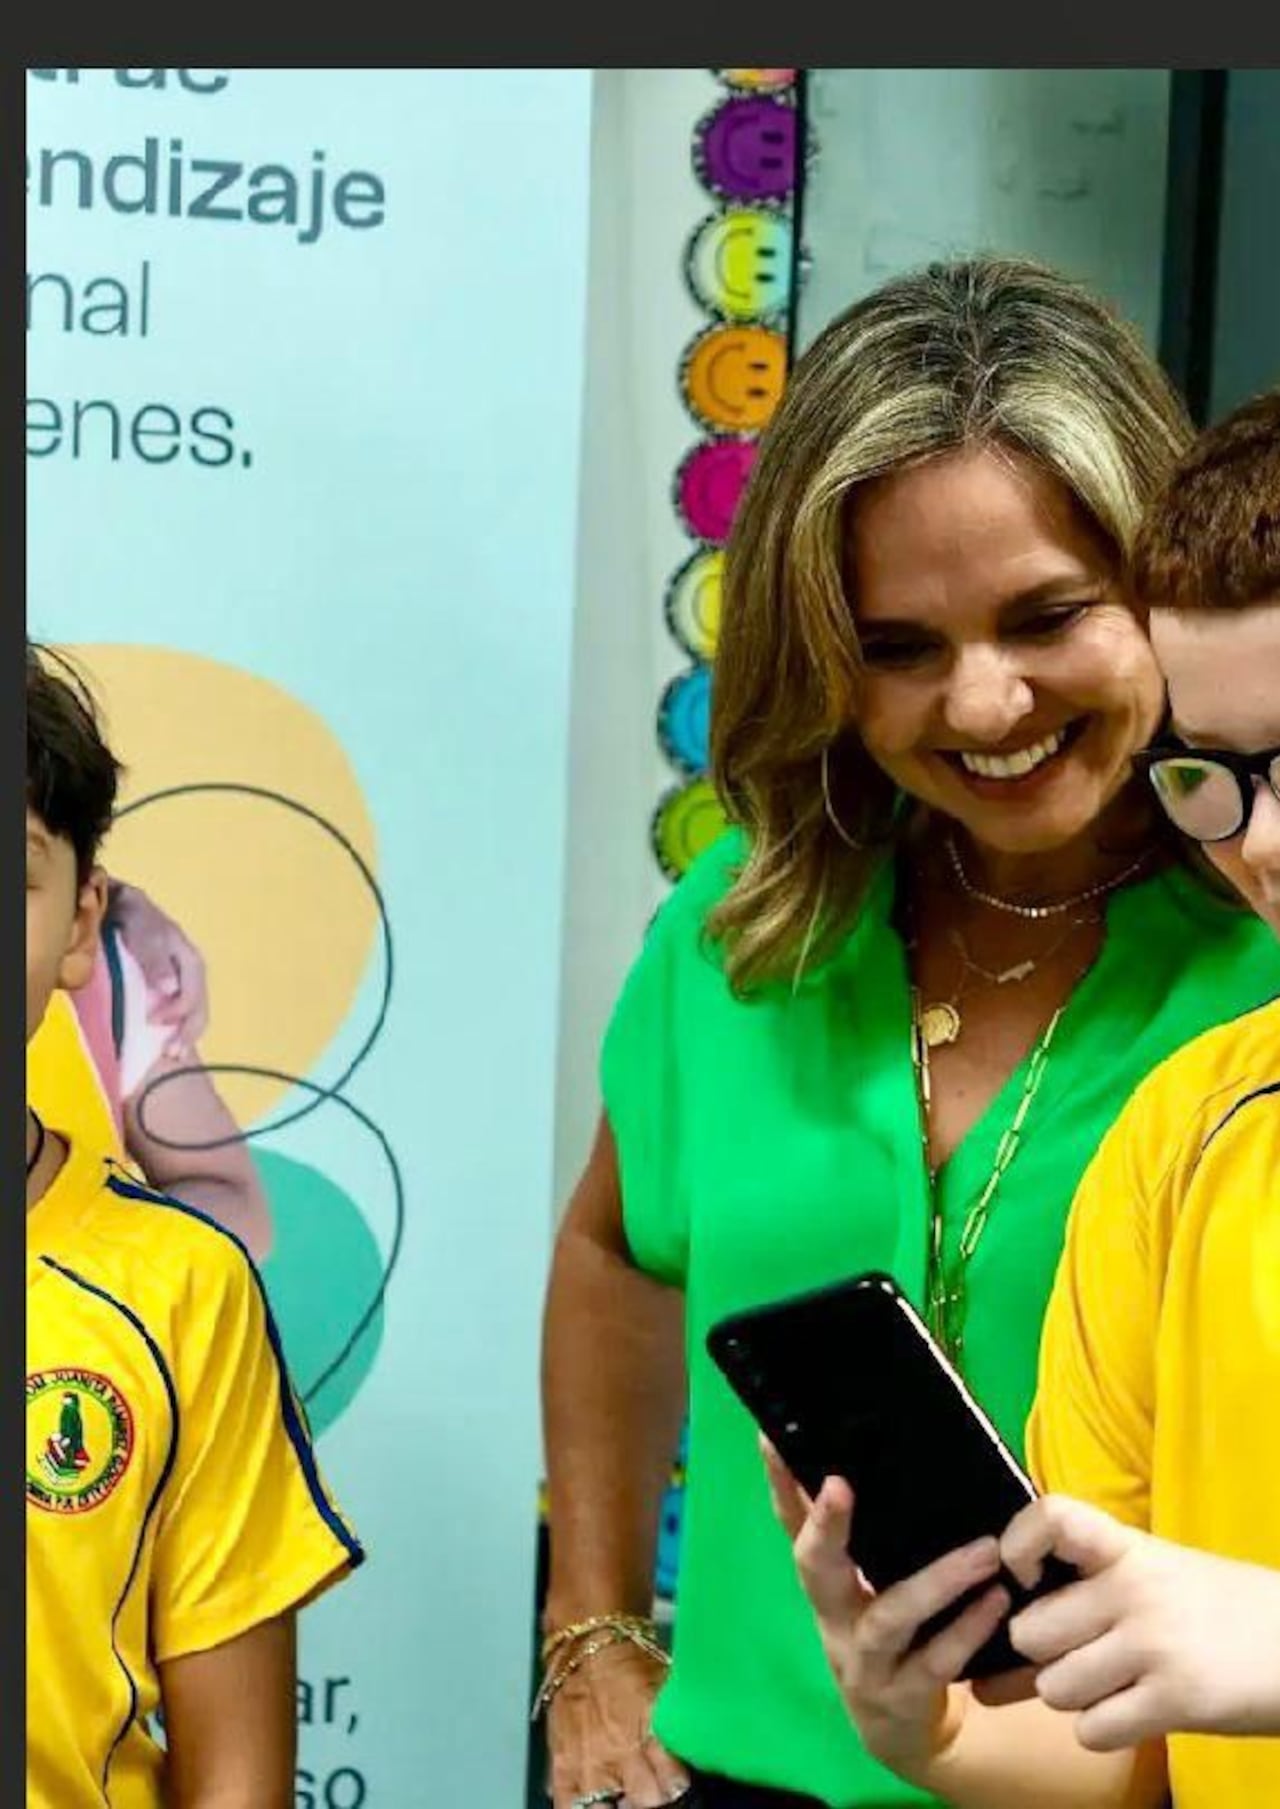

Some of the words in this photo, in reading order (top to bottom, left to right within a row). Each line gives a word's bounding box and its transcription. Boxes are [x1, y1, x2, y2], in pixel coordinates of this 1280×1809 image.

[26, 137, 386, 244] ndizaje
[26, 260, 150, 337] nal
[26, 397, 254, 469] enes.
